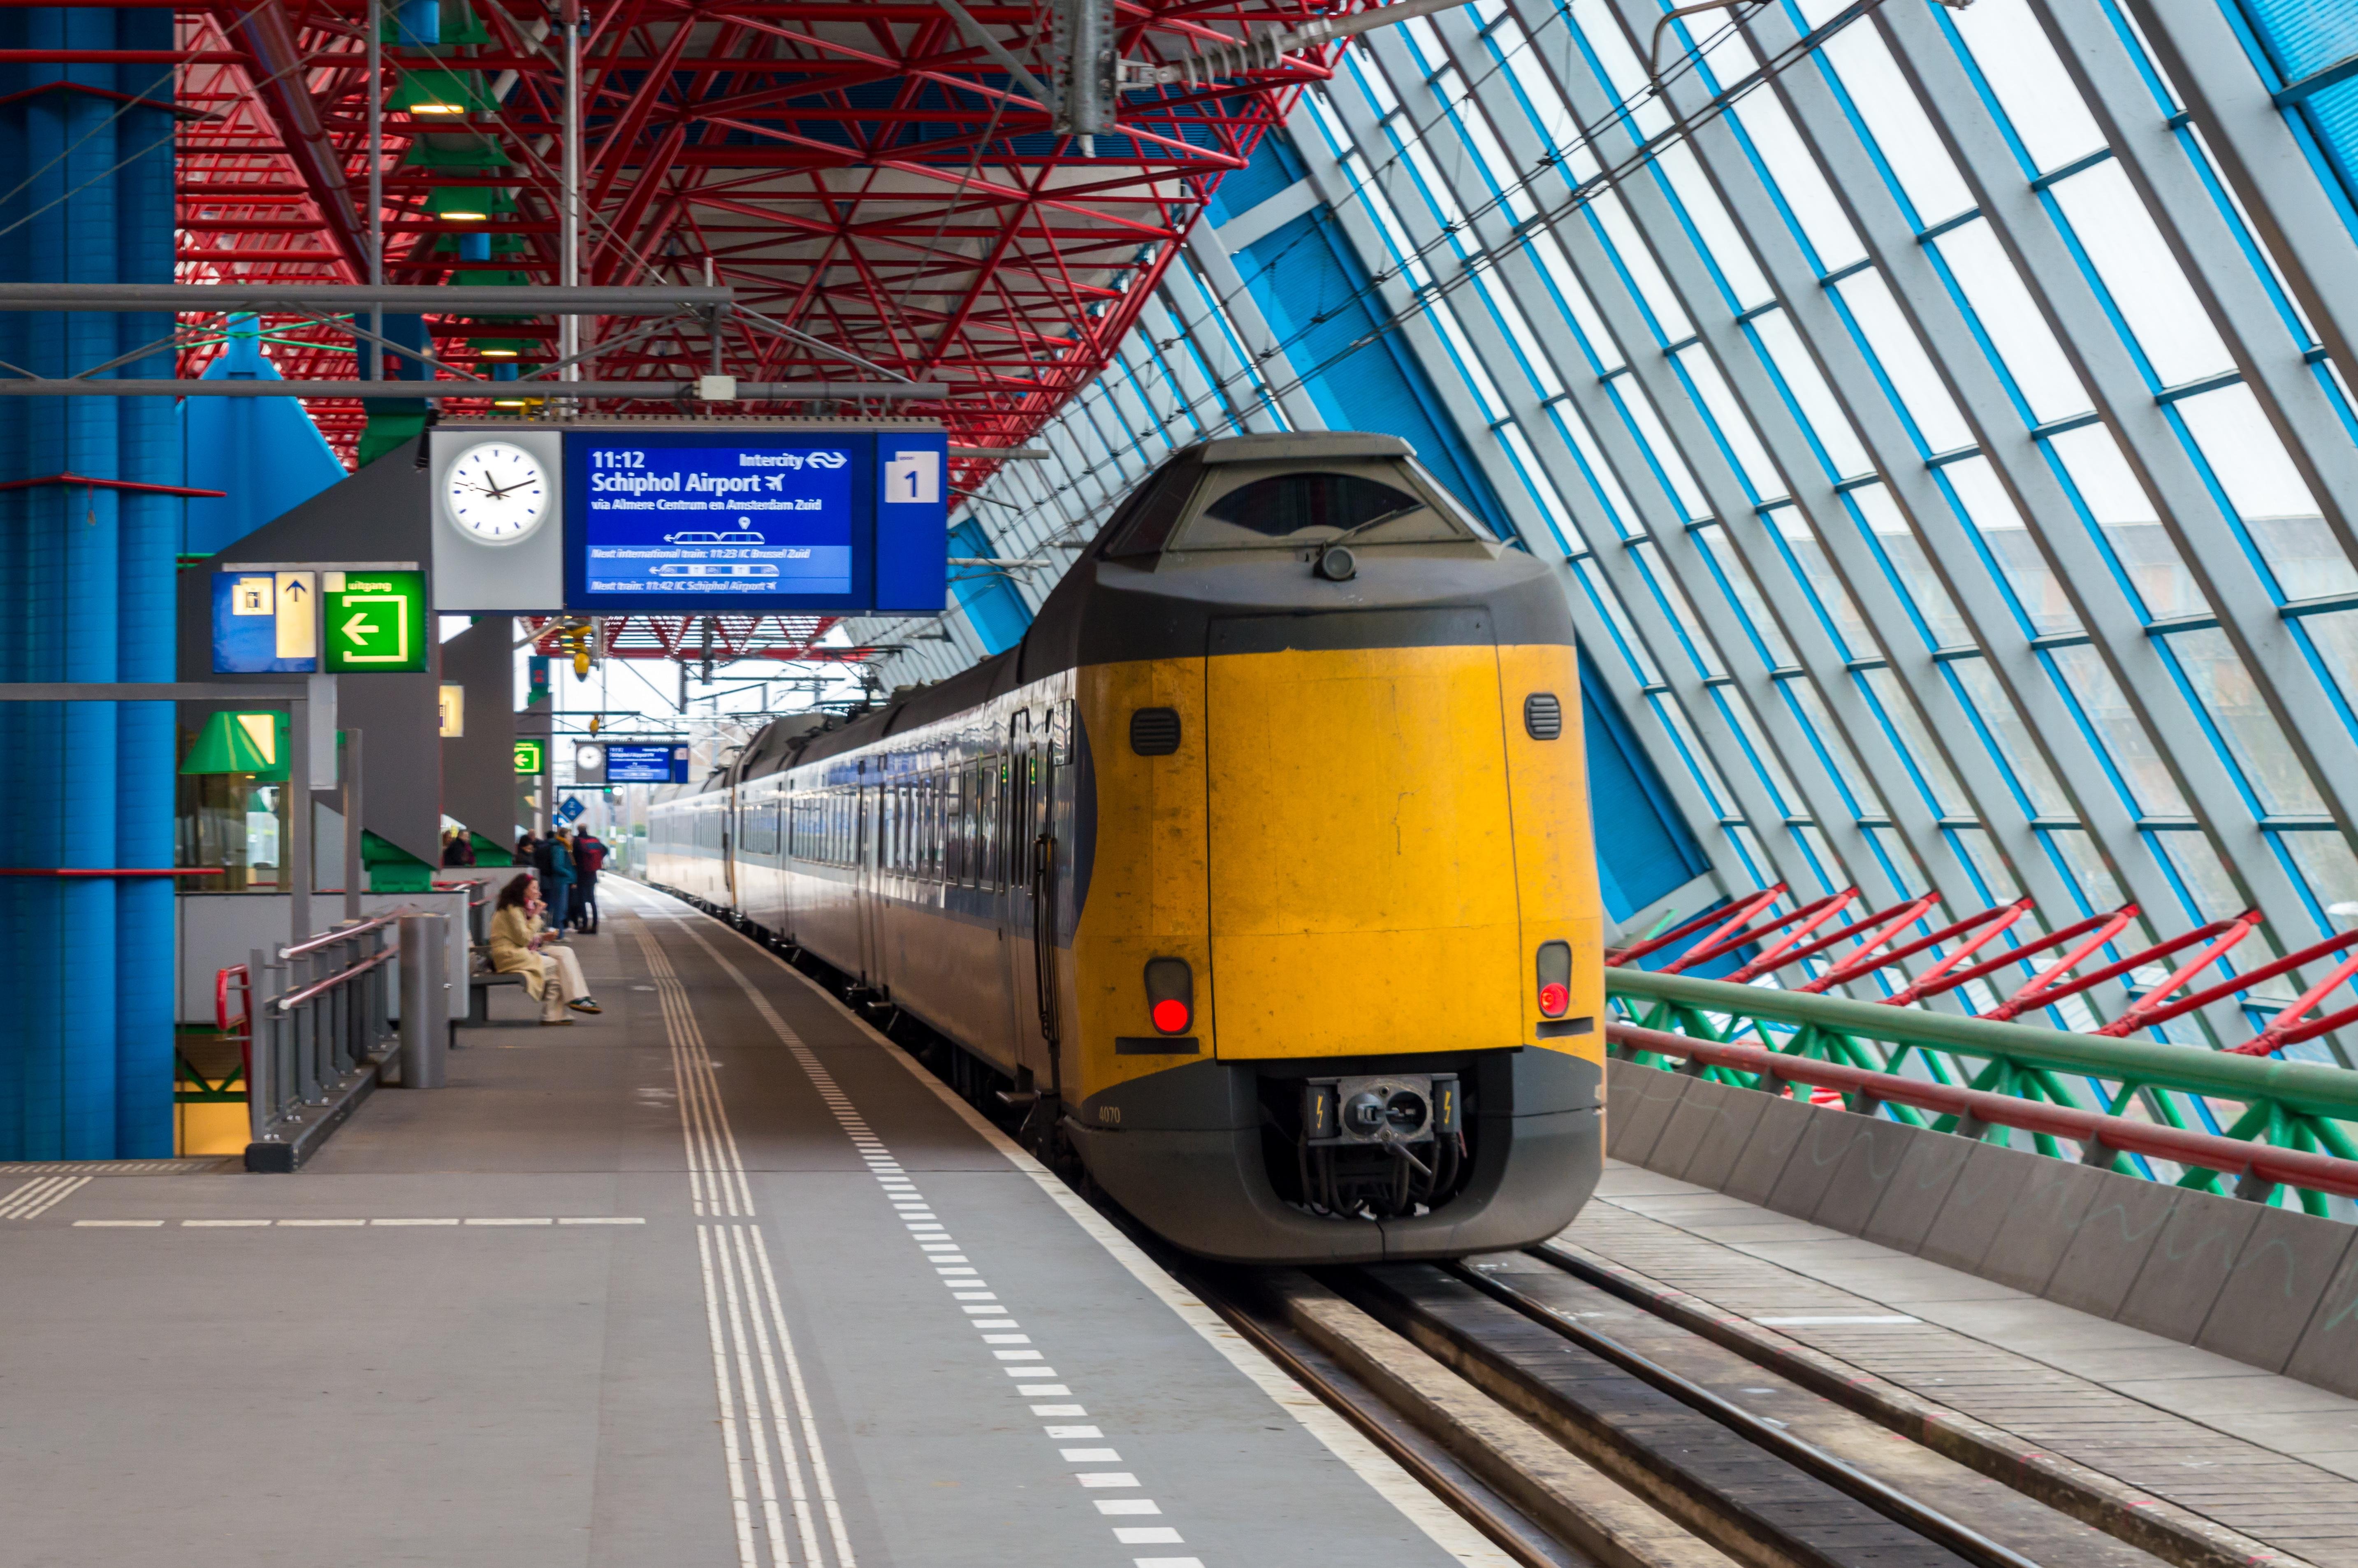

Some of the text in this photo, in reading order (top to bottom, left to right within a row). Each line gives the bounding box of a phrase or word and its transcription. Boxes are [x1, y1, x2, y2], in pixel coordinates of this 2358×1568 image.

[592, 451, 645, 468] 11:12
[739, 453, 805, 470] Intercity
[591, 471, 761, 496] Schiphol Airport
[904, 471, 918, 498] 1
[591, 498, 822, 510] via Almere Centrum en Amsterdam Zuid
[591, 548, 617, 558] Next
[617, 549, 681, 558] international
[738, 549, 750, 558] IC
[750, 549, 787, 558] Brussel
[787, 549, 811, 559] Zuid
[591, 581, 617, 590] Next
[674, 581, 686, 590] IC
[686, 581, 728, 592] Schiphol
[729, 581, 765, 592] Airport
[1099, 1106, 1120, 1123] 4070
